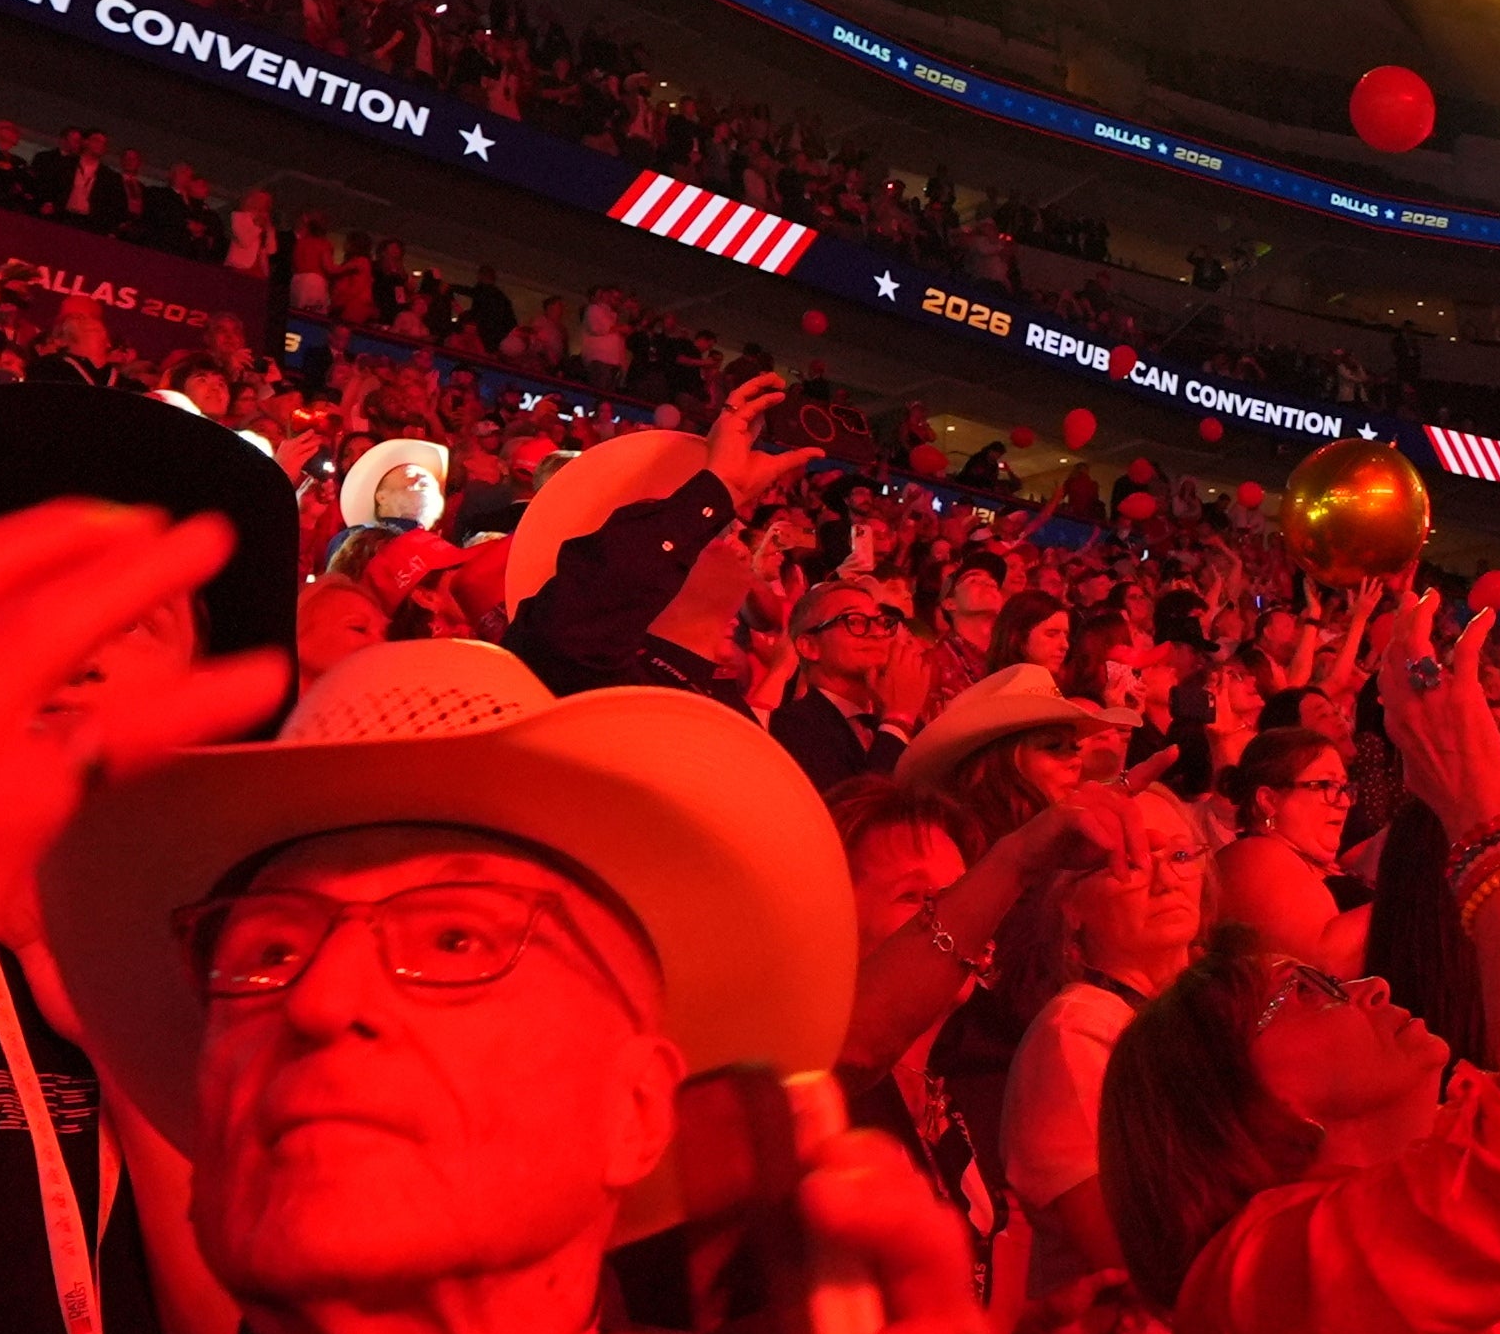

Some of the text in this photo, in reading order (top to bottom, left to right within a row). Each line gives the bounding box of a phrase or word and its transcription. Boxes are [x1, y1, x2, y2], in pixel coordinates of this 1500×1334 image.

[833, 26, 968, 94] DALLAS 2026
[1094, 123, 1223, 171] DALLAS 2026
[1330, 193, 1449, 229] DALLAS 2026
[22, 265, 209, 330] ALLAS 202
[921, 287, 1343, 439] 2026 REPUBCAN CONVENTION
